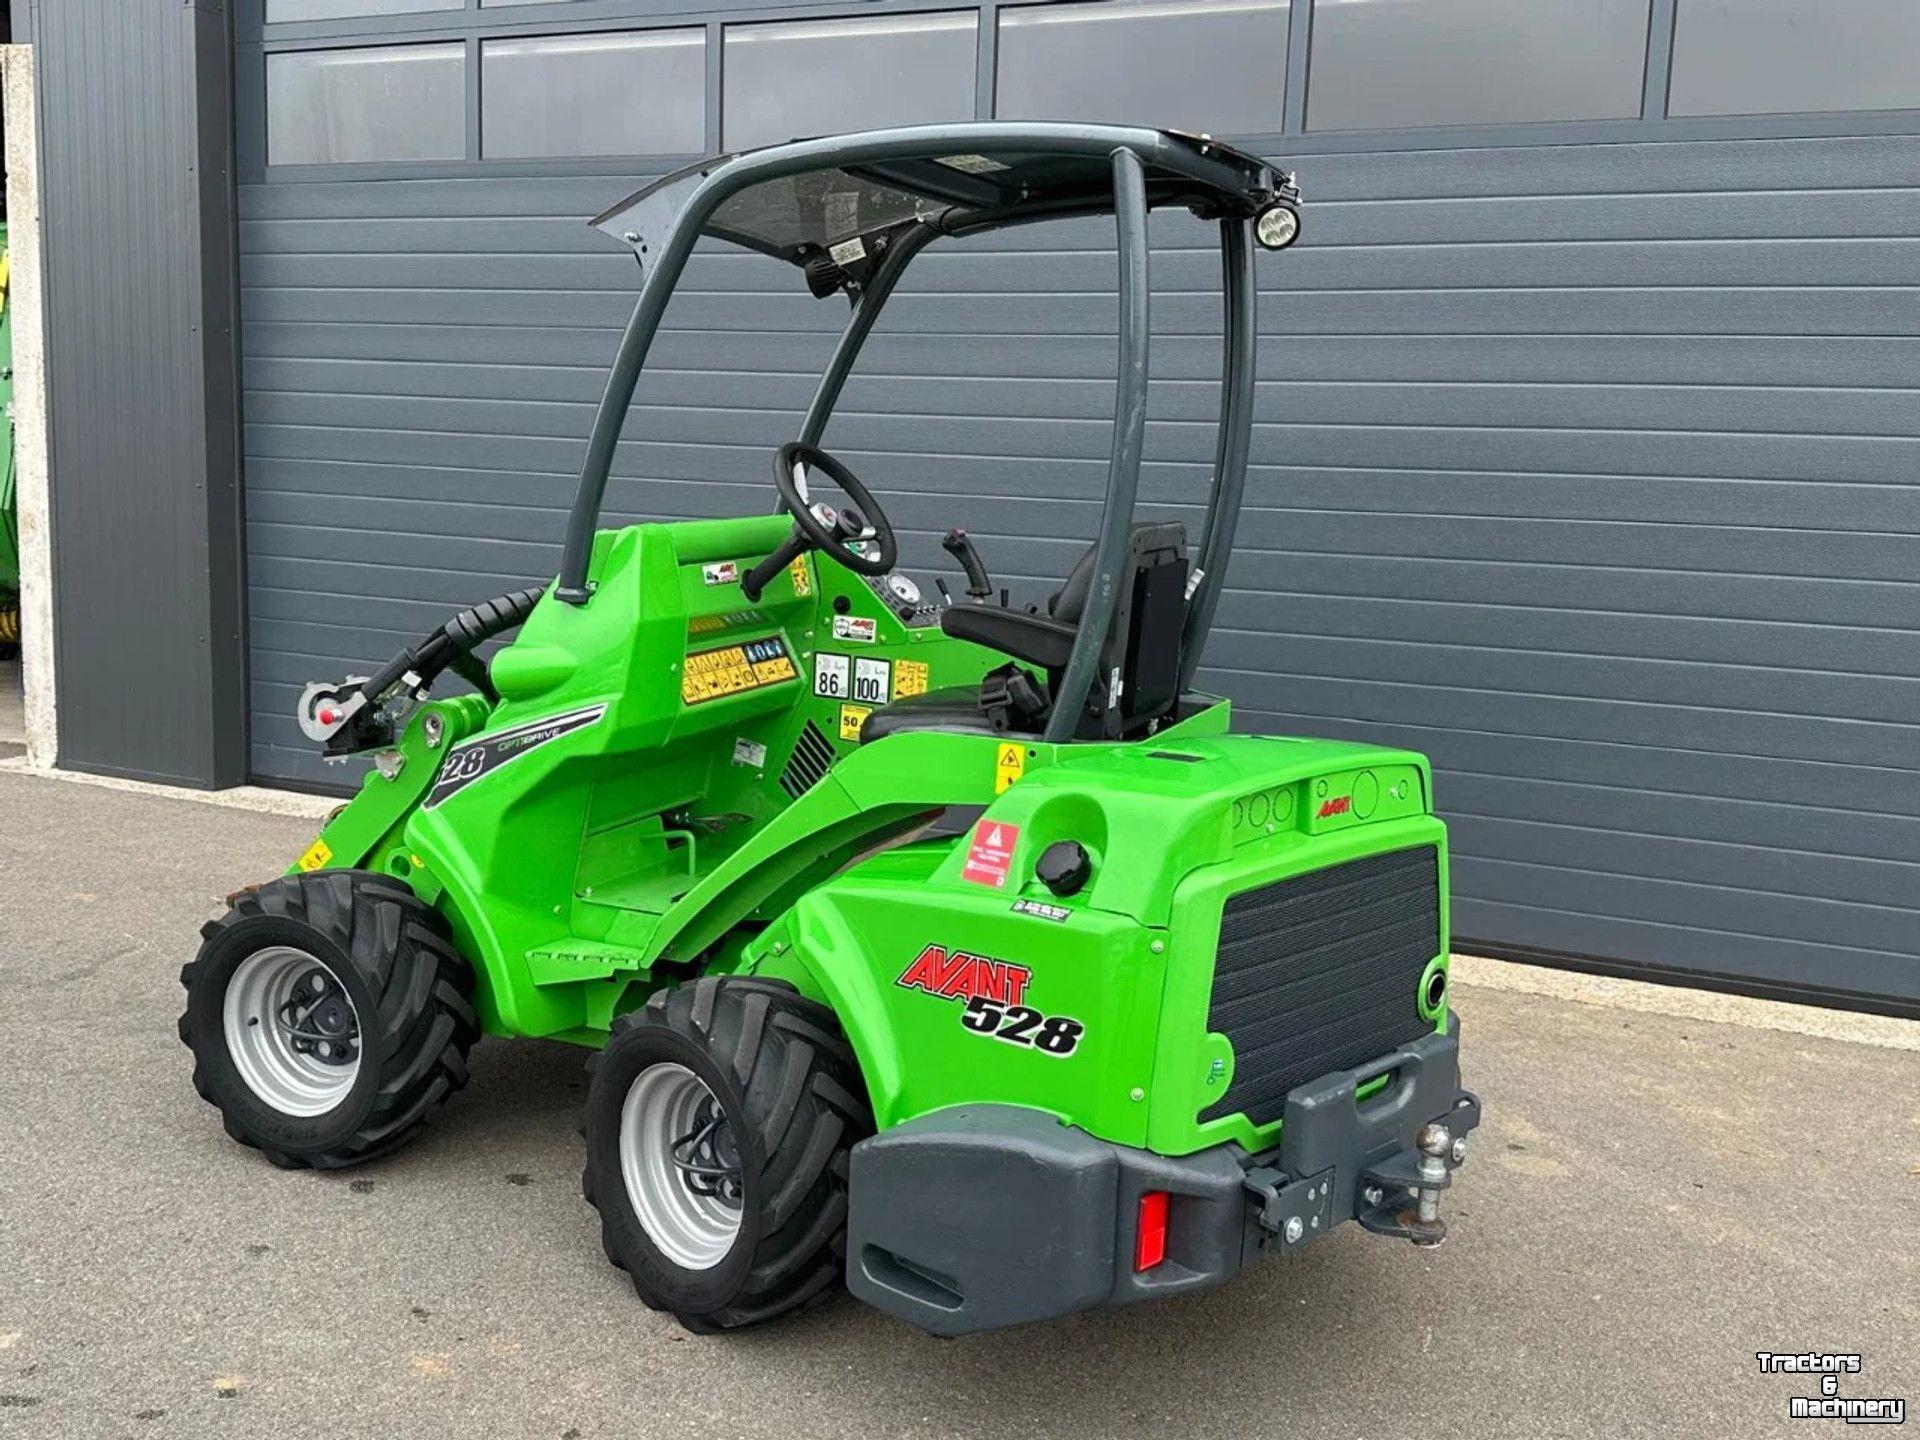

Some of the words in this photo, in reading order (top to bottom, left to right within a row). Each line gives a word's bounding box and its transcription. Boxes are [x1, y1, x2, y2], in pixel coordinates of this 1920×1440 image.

[819, 672, 839, 694] 86
[857, 677, 879, 700] 100
[843, 716, 858, 727] 50
[437, 746, 486, 785] 28
[894, 943, 1033, 1007] AVANT
[961, 995, 1085, 1058] 528
